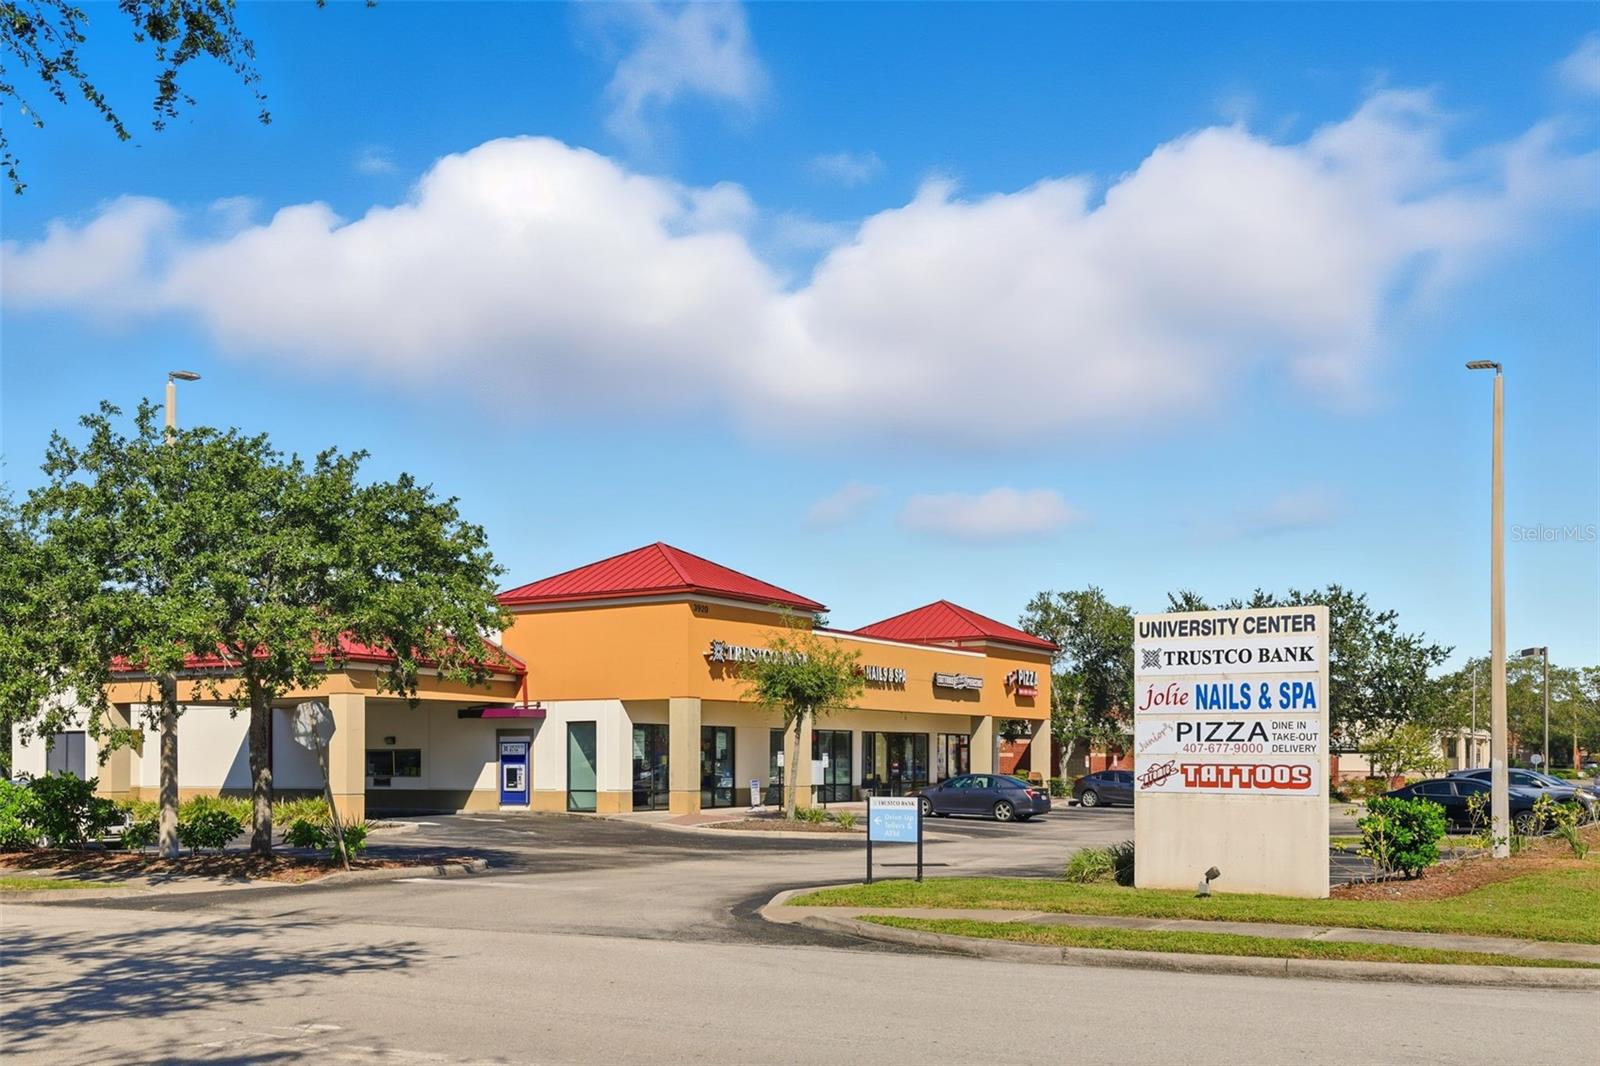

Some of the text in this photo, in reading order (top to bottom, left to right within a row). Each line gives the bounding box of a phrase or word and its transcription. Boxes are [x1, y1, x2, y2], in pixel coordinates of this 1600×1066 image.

[1139, 614, 1316, 639] UNIVERSITY CENTER
[1164, 645, 1314, 667] TRUSTCO BANK
[865, 665, 888, 682] NAILS
[1139, 681, 1317, 711] jolie NAILS & SPA
[1272, 721, 1307, 730] DINE IN
[1139, 721, 1269, 753] Junior's PIZZA
[1272, 732, 1319, 742] TAKE-OUT
[1183, 743, 1264, 754] 407-677-9000
[1272, 744, 1317, 753] DELIVERY
[1181, 763, 1312, 790] TATTOOS
